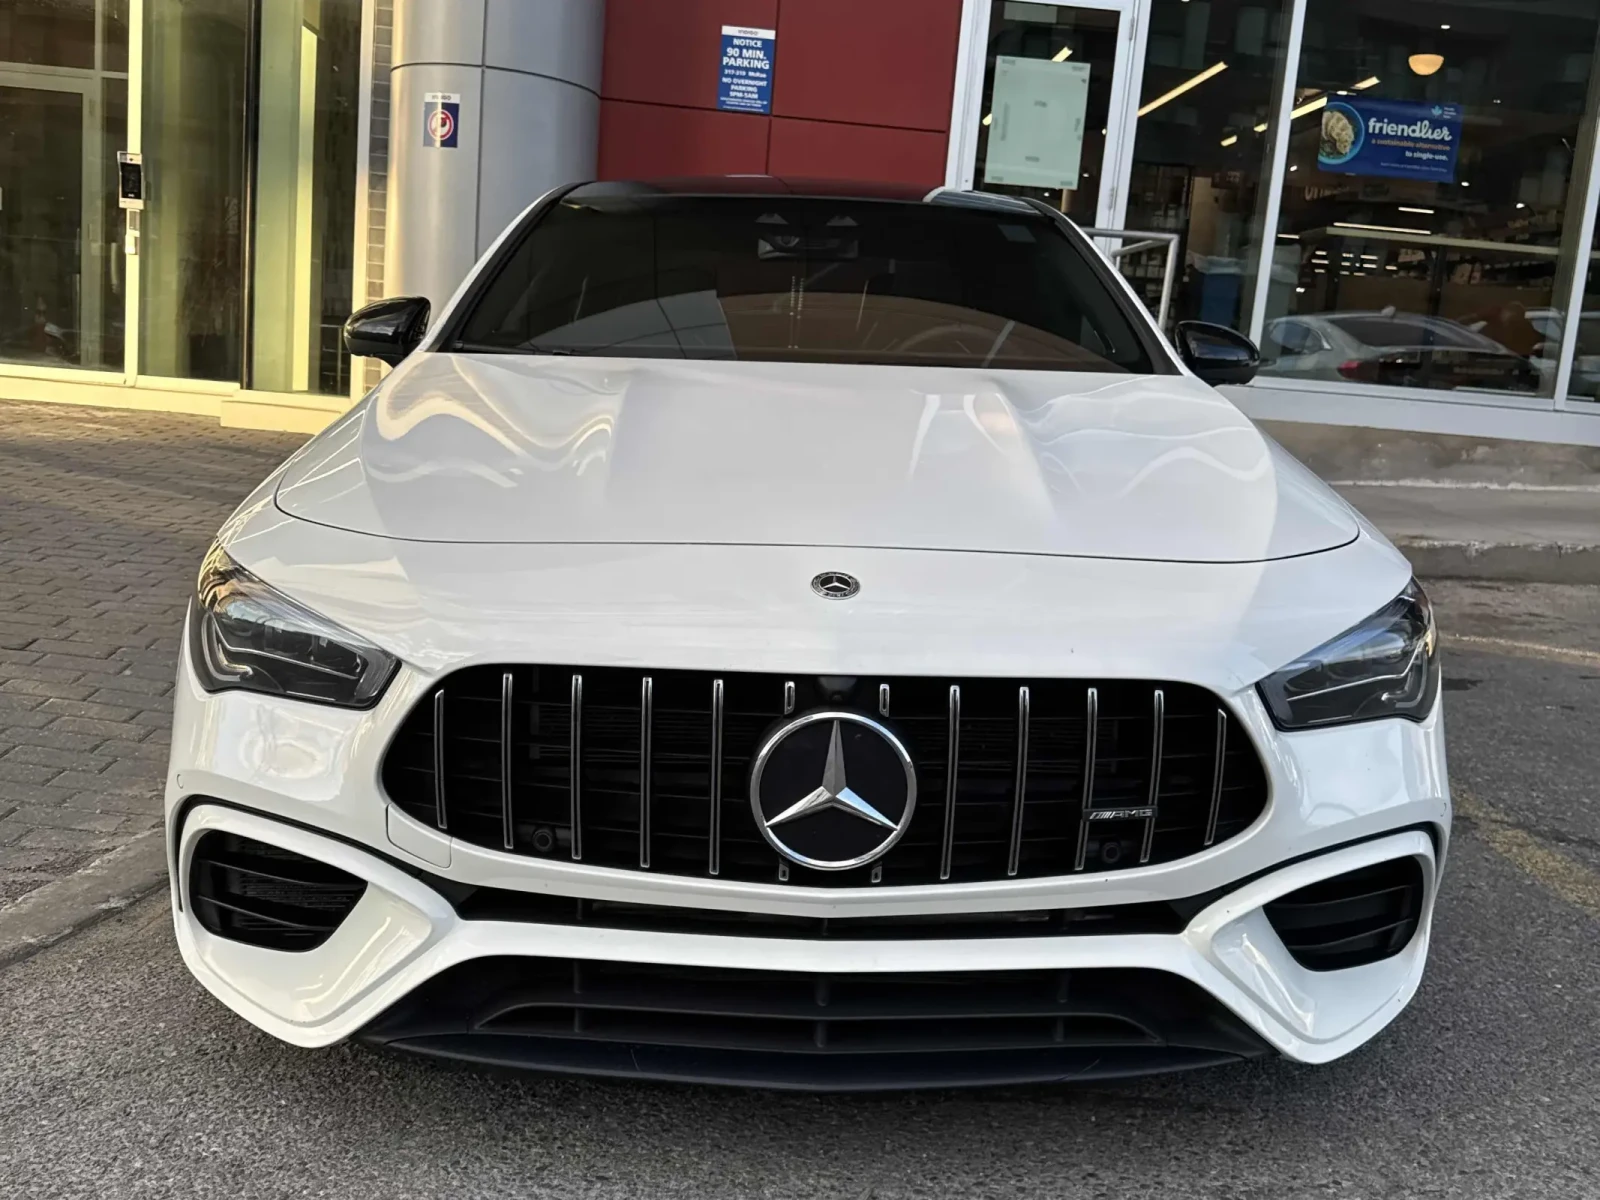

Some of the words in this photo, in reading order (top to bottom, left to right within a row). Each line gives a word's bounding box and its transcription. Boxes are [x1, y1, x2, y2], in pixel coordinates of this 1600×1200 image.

[733, 38, 763, 48] NOTICE
[726, 47, 740, 57] 90
[742, 48, 767, 60] MIN.
[722, 56, 770, 70] PARKING
[732, 78, 768, 87] OVERNIGHT
[730, 84, 758, 93] PARKING
[1368, 117, 1453, 141] friendlier
[1108, 808, 1153, 819] AMG
